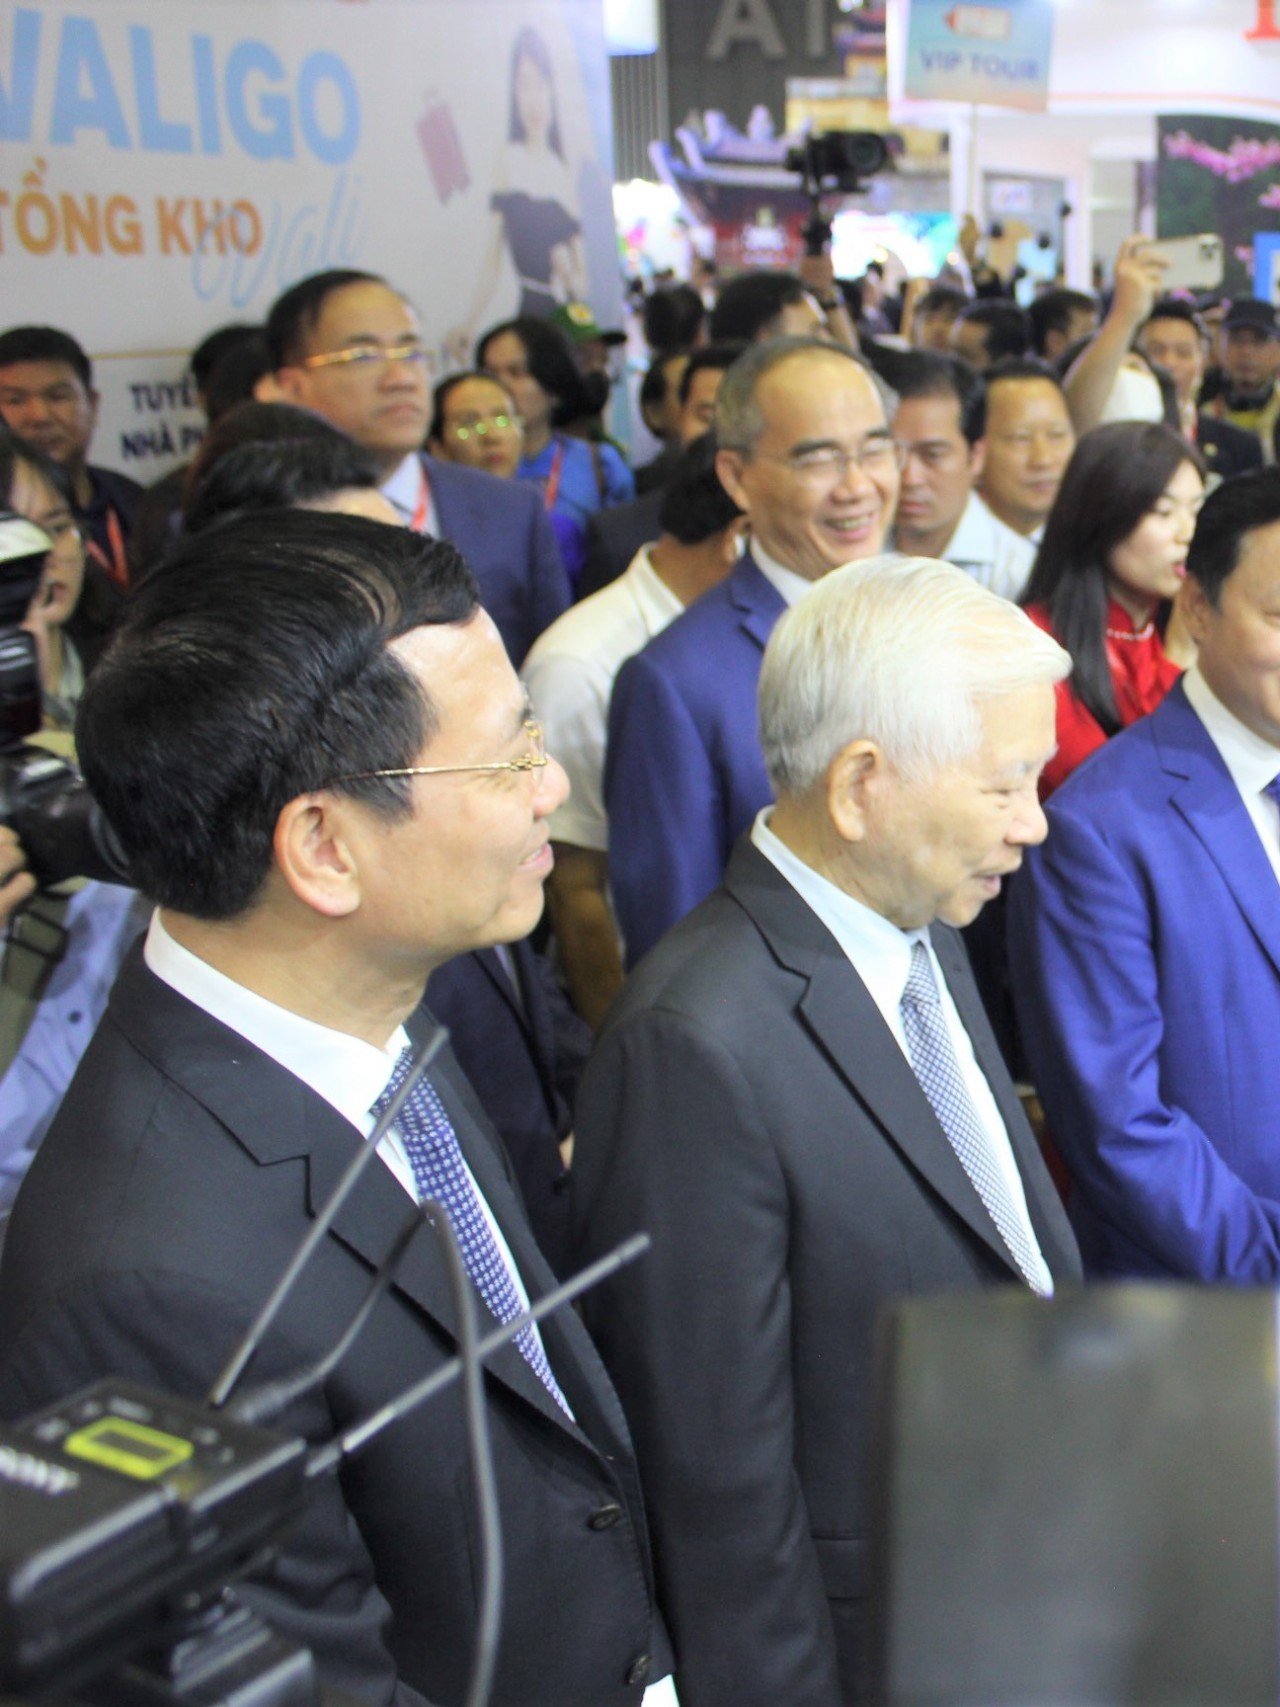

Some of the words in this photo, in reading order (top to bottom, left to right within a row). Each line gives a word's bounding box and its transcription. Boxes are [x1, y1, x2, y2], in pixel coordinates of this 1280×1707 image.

[919, 49, 961, 73] VIP
[969, 52, 1042, 81] TOUR
[0, 155, 146, 257] ỔNG
[156, 196, 262, 257] KHO
